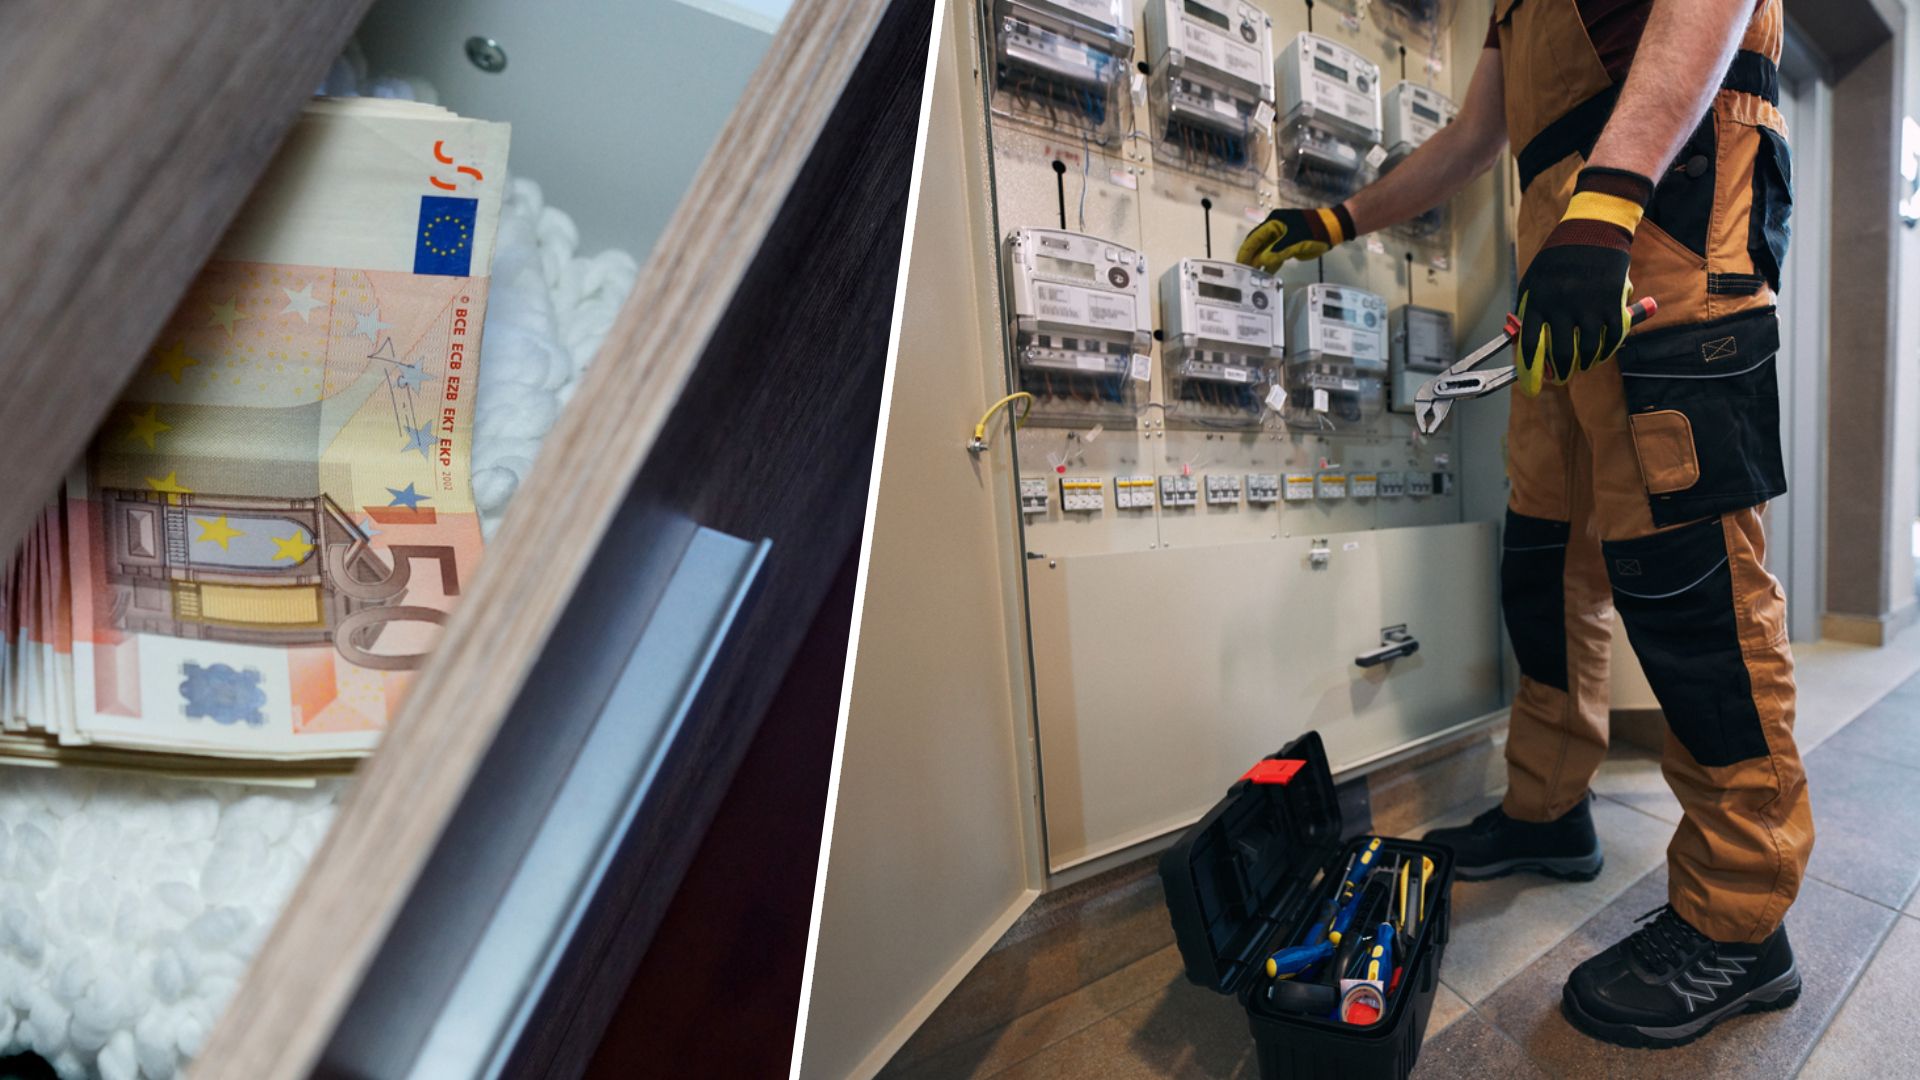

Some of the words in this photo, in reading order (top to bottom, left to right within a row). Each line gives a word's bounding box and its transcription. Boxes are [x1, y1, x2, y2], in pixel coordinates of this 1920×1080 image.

[453, 308, 468, 336] BCE
[450, 343, 464, 370] ECB
[446, 376, 460, 401] EZB
[443, 408, 456, 433] EKT
[439, 438, 452, 467] EKP
[442, 471, 453, 491] 2002
[329, 544, 461, 671] 50
